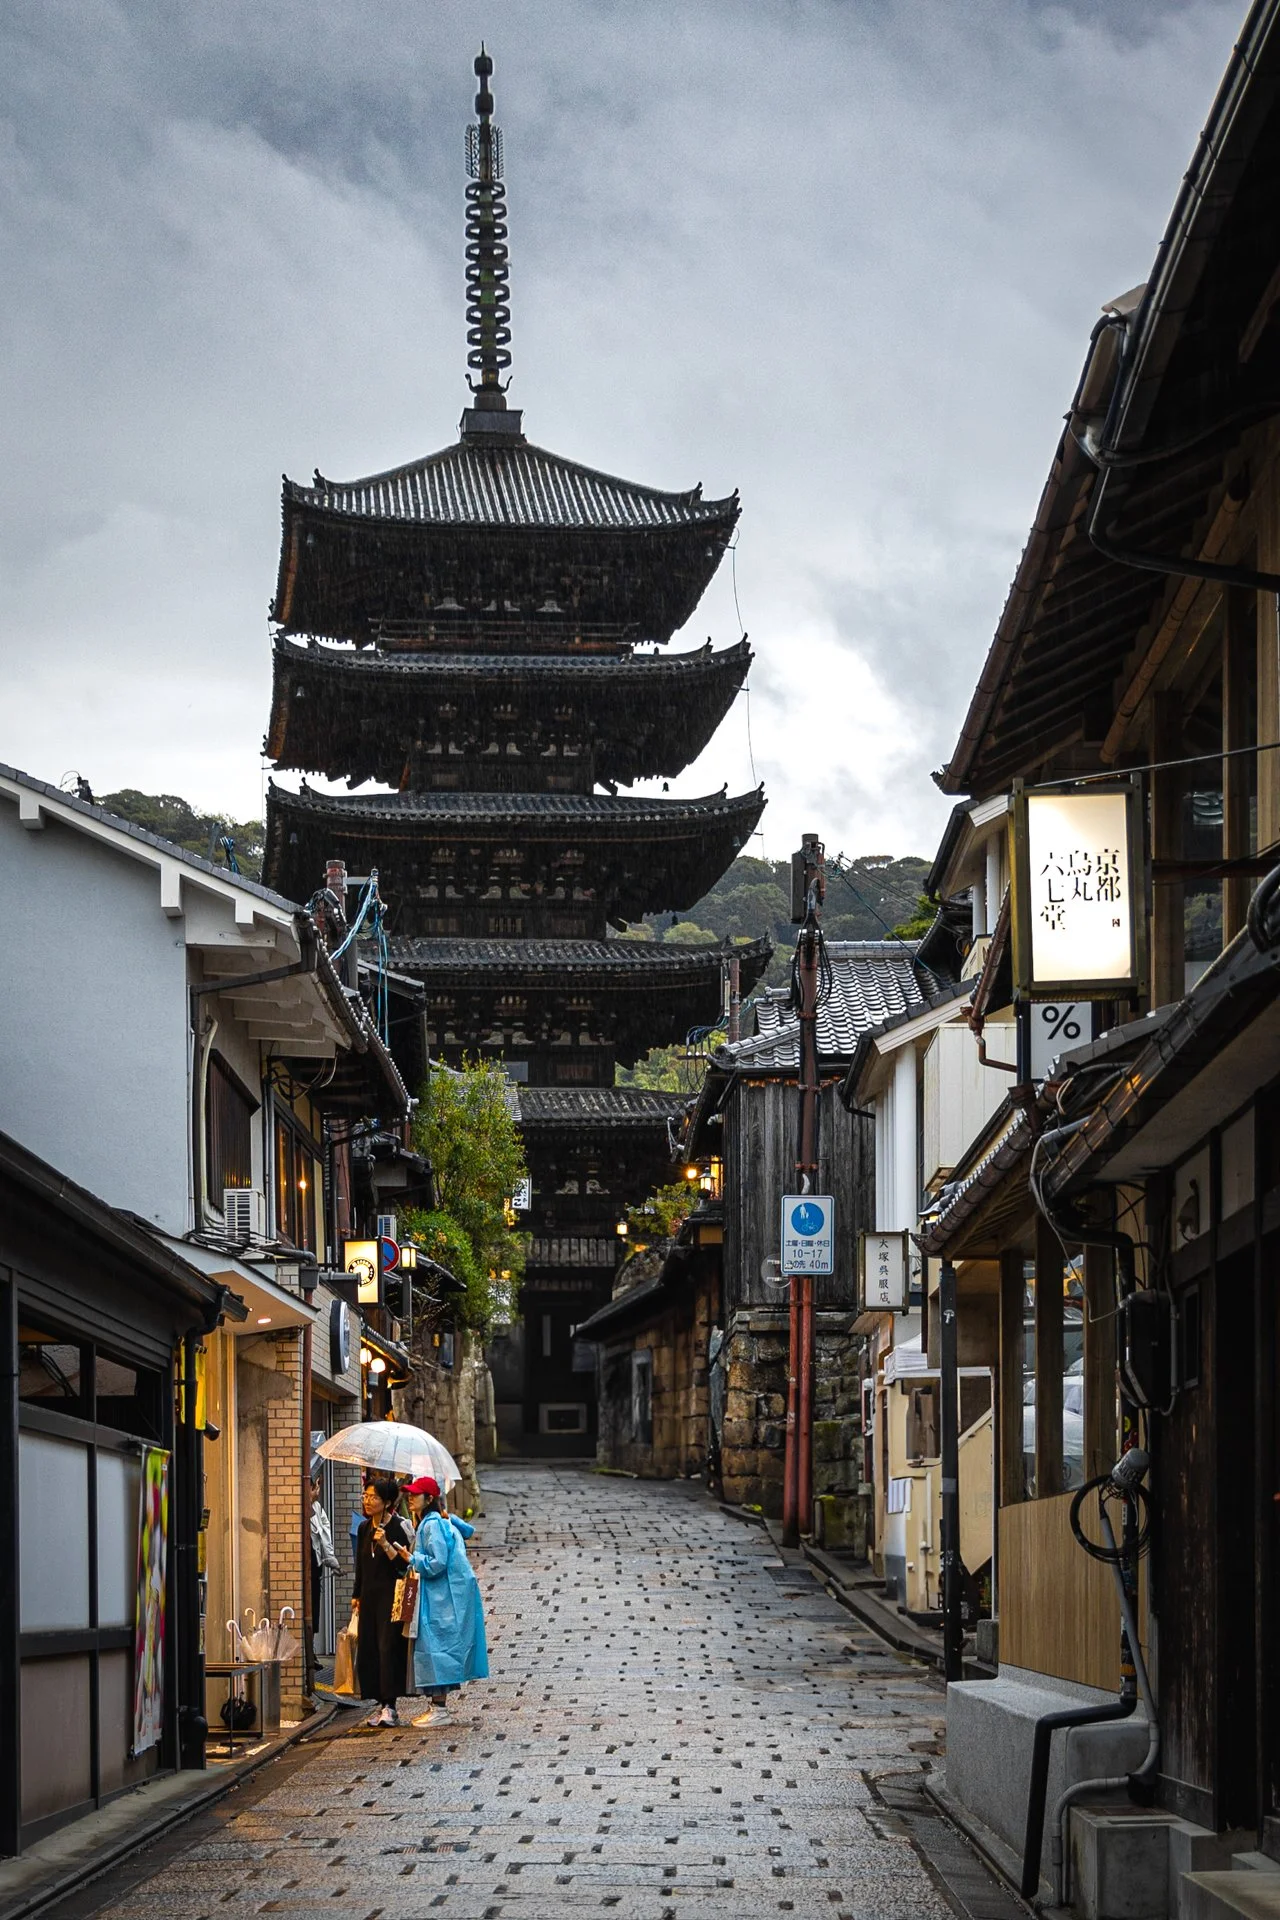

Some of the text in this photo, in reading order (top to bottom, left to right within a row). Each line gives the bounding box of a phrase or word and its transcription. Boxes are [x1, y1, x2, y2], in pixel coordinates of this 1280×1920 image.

[1095, 849, 1120, 902] 京都
[1041, 1005, 1081, 1040] %
[809, 1259, 829, 1269] 40m
